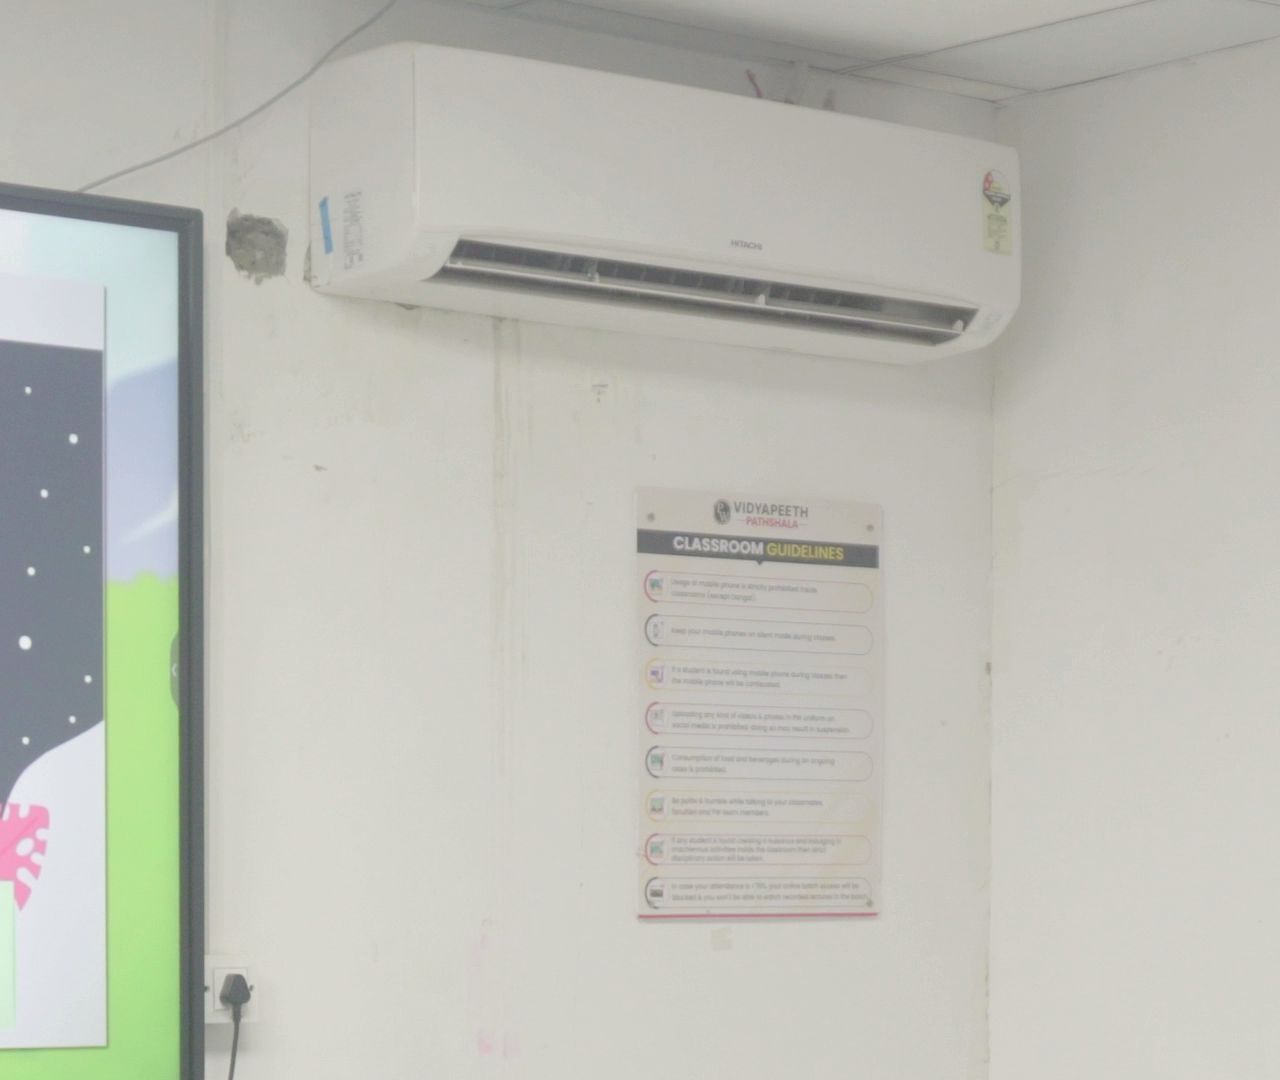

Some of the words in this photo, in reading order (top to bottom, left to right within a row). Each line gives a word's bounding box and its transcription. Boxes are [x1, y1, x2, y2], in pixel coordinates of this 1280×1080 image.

[734, 501, 808, 518] VIDYAPEETH
[745, 516, 799, 529] PATHSHALA
[673, 535, 764, 555] CLASSROOM
[766, 543, 844, 561] GUIDELINES
